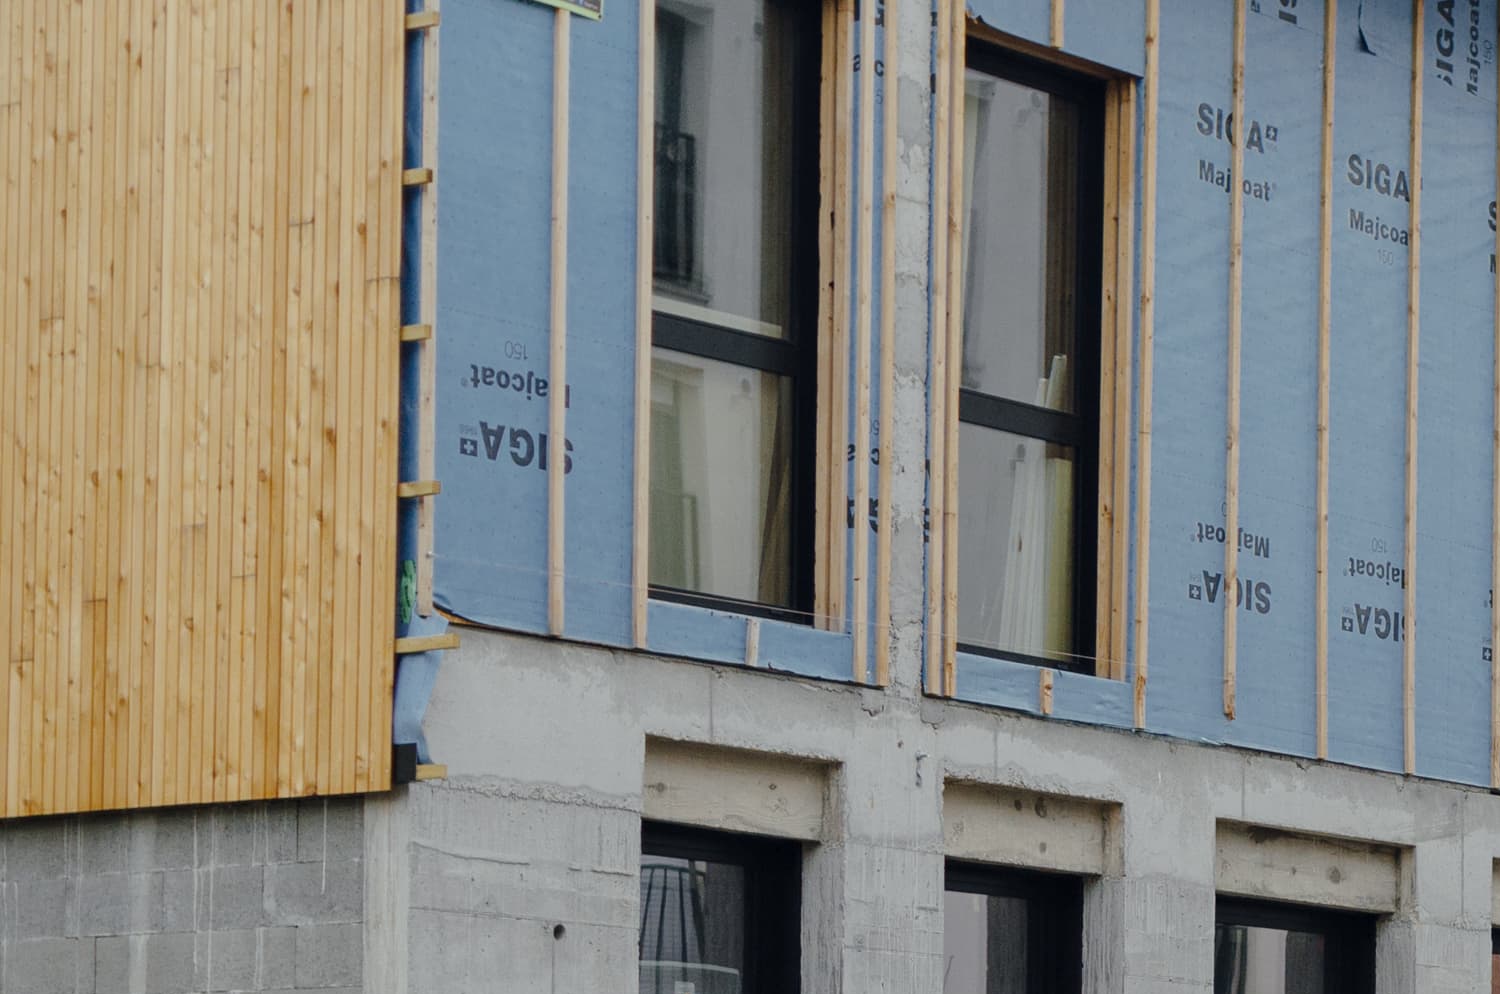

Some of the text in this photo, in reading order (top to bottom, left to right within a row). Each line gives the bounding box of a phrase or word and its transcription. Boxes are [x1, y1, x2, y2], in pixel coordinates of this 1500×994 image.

[1200, 160, 1270, 202] Majoat
[1348, 154, 1410, 202] SIGA
[1350, 208, 1408, 246] Majcoa
[505, 340, 528, 360] 150
[470, 364, 570, 408] ajcoat
[1197, 522, 1270, 558] Majoat
[1349, 557, 1406, 590] ajcoat
